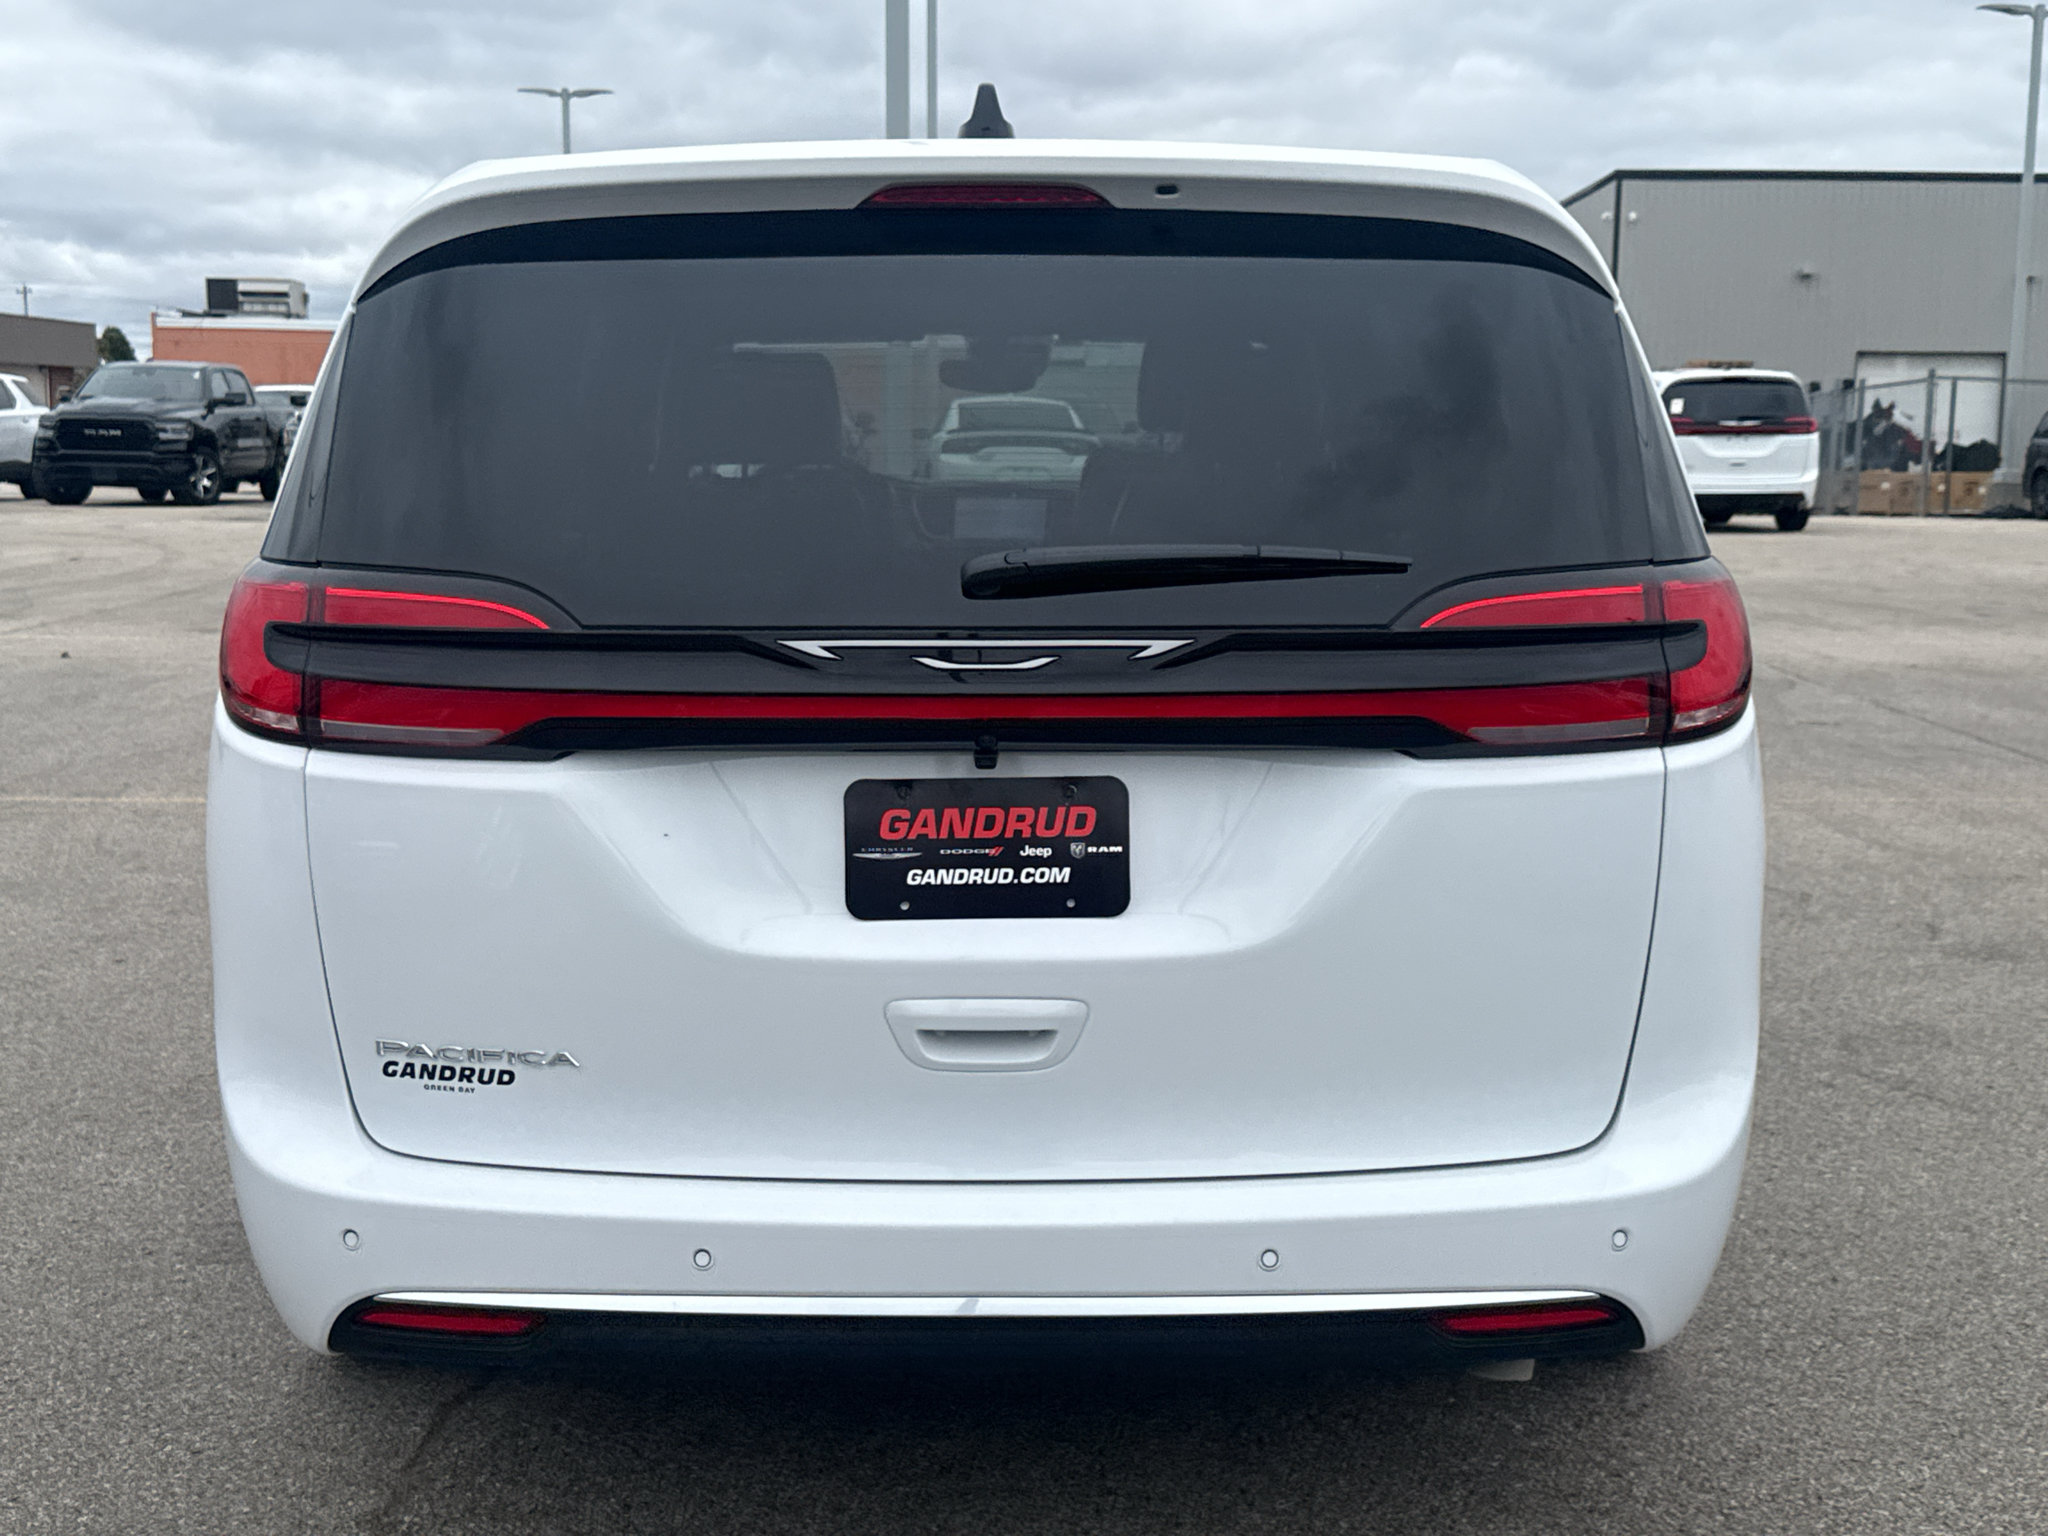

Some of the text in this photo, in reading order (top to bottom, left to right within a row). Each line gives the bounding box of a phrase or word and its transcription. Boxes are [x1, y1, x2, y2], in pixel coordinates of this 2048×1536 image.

[879, 805, 1096, 840] GANDRUD
[1019, 845, 1052, 858] Jeep
[906, 867, 1070, 885] GANDRUD.COM
[375, 1039, 580, 1067] PACIFICA
[382, 1060, 516, 1086] GANDRUD
[423, 1084, 475, 1094] GREEN BAY
